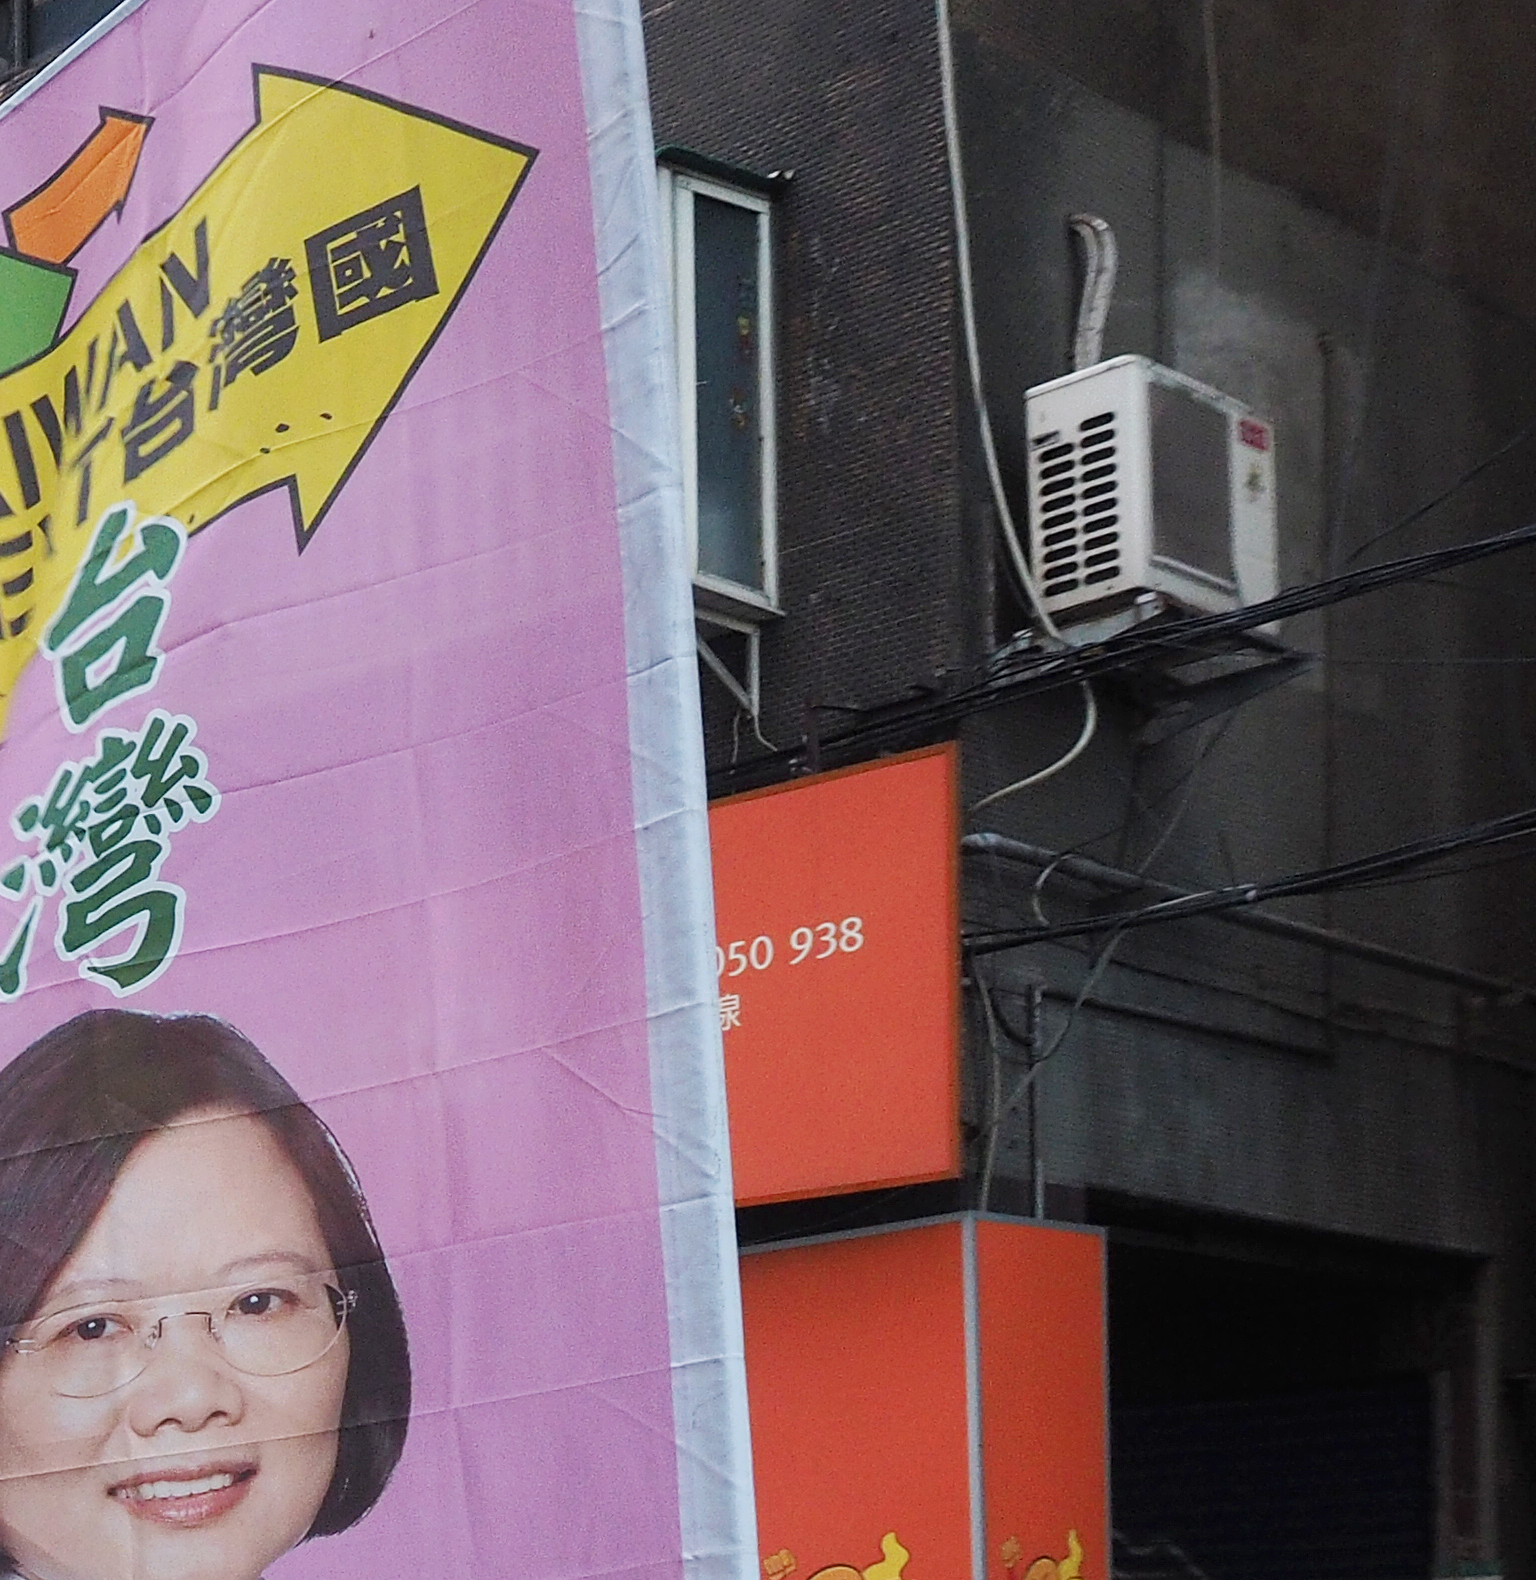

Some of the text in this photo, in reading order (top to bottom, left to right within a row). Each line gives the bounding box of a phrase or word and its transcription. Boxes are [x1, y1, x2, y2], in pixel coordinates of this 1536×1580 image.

[123, 185, 440, 484] 台灣國
[789, 916, 864, 966] 938
